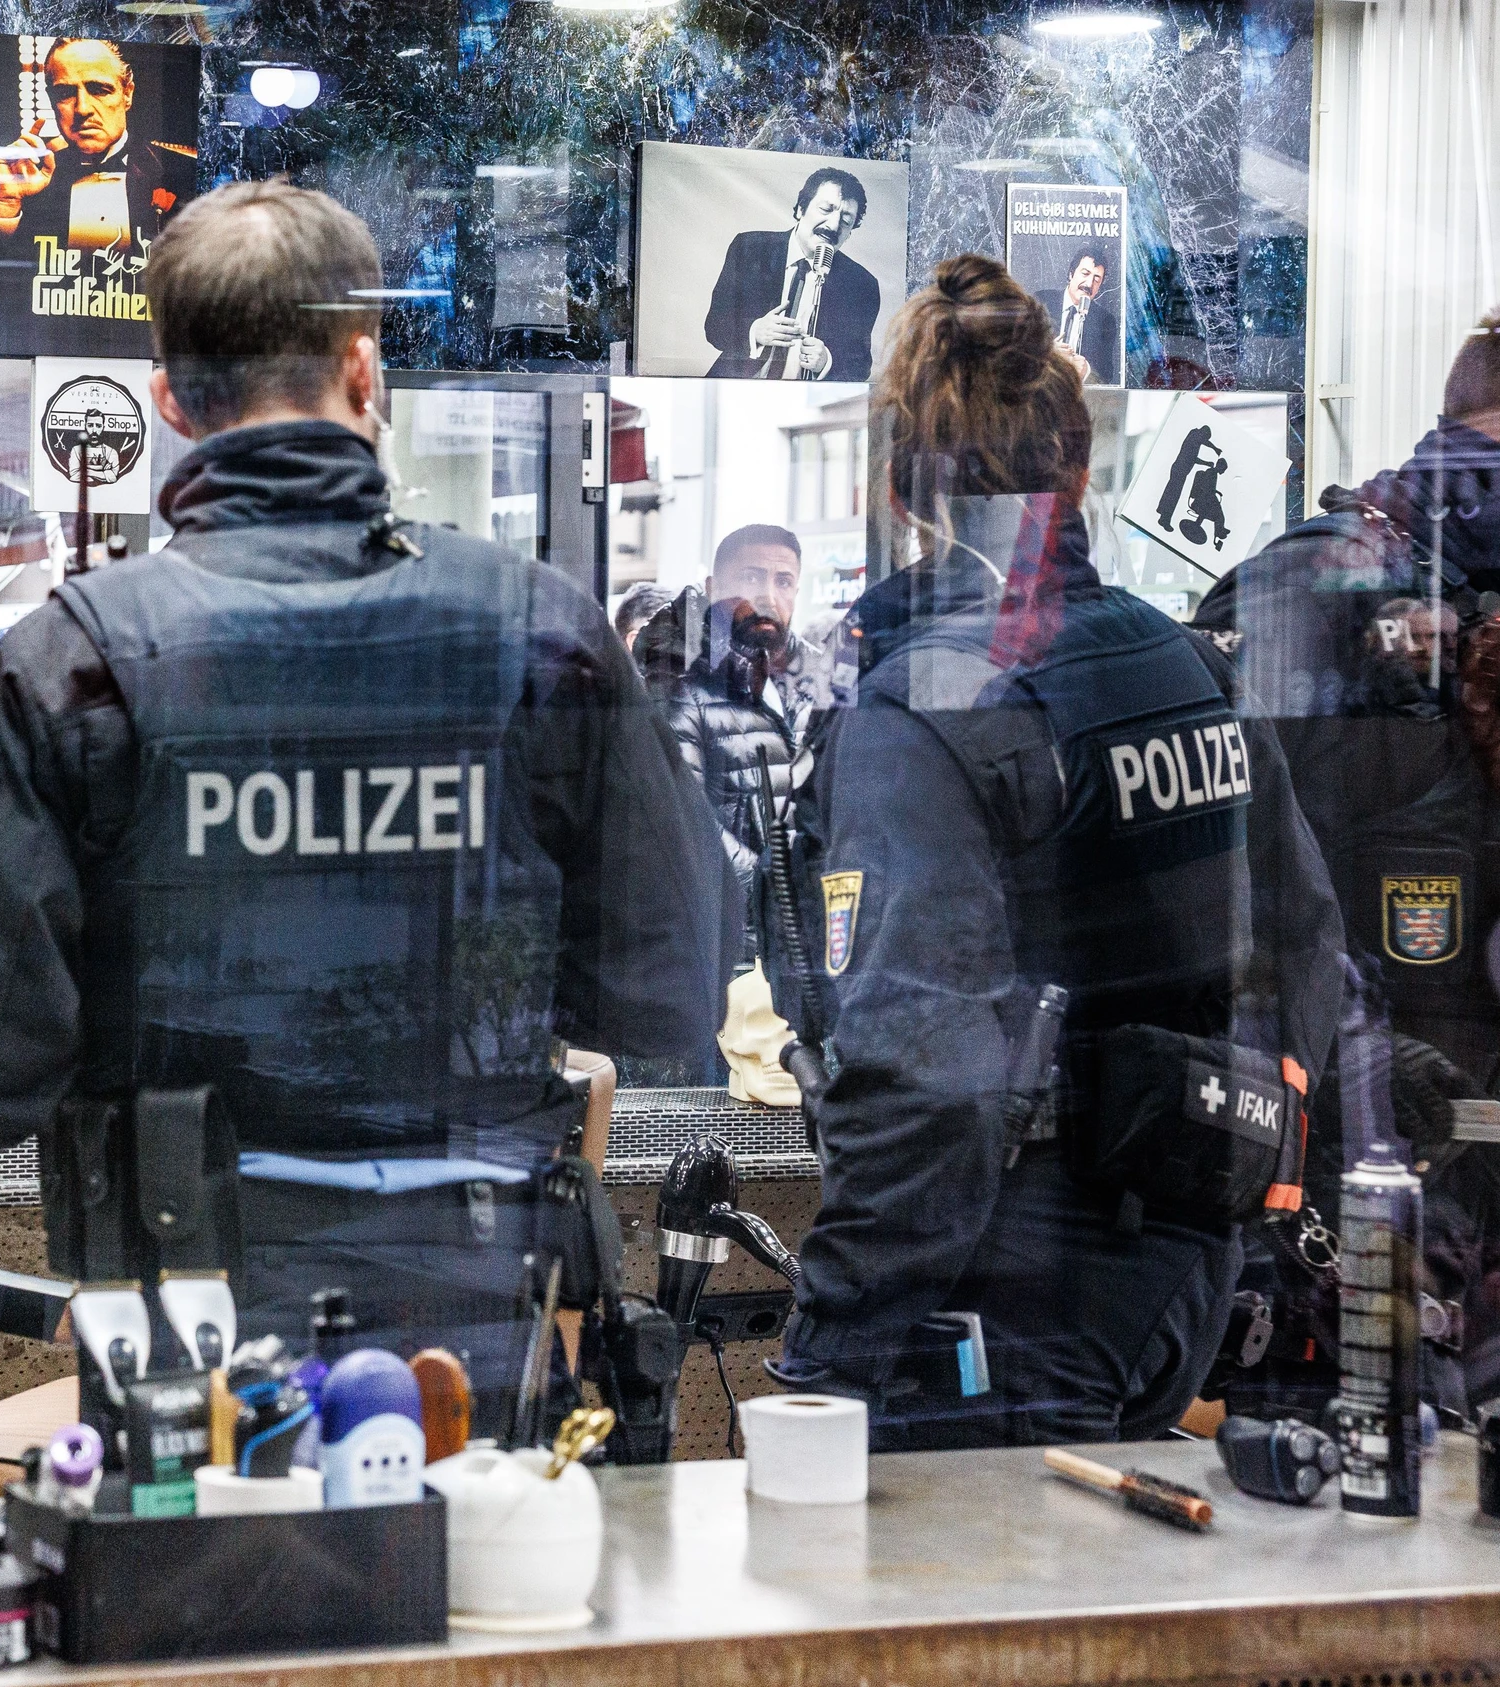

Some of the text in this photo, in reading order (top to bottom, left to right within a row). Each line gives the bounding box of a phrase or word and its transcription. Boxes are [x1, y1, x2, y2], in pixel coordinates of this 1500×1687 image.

[1068, 203, 1119, 219] SEVMEK
[1013, 220, 1120, 237] RUHUMUZDA VAR
[33, 235, 82, 276] The
[50, 414, 131, 433] Barber Shop
[1109, 721, 1252, 821] POLIZEI
[186, 764, 486, 857] POLIZEI
[1386, 880, 1458, 895] POLIZEI
[1235, 1088, 1280, 1131] IFAK
